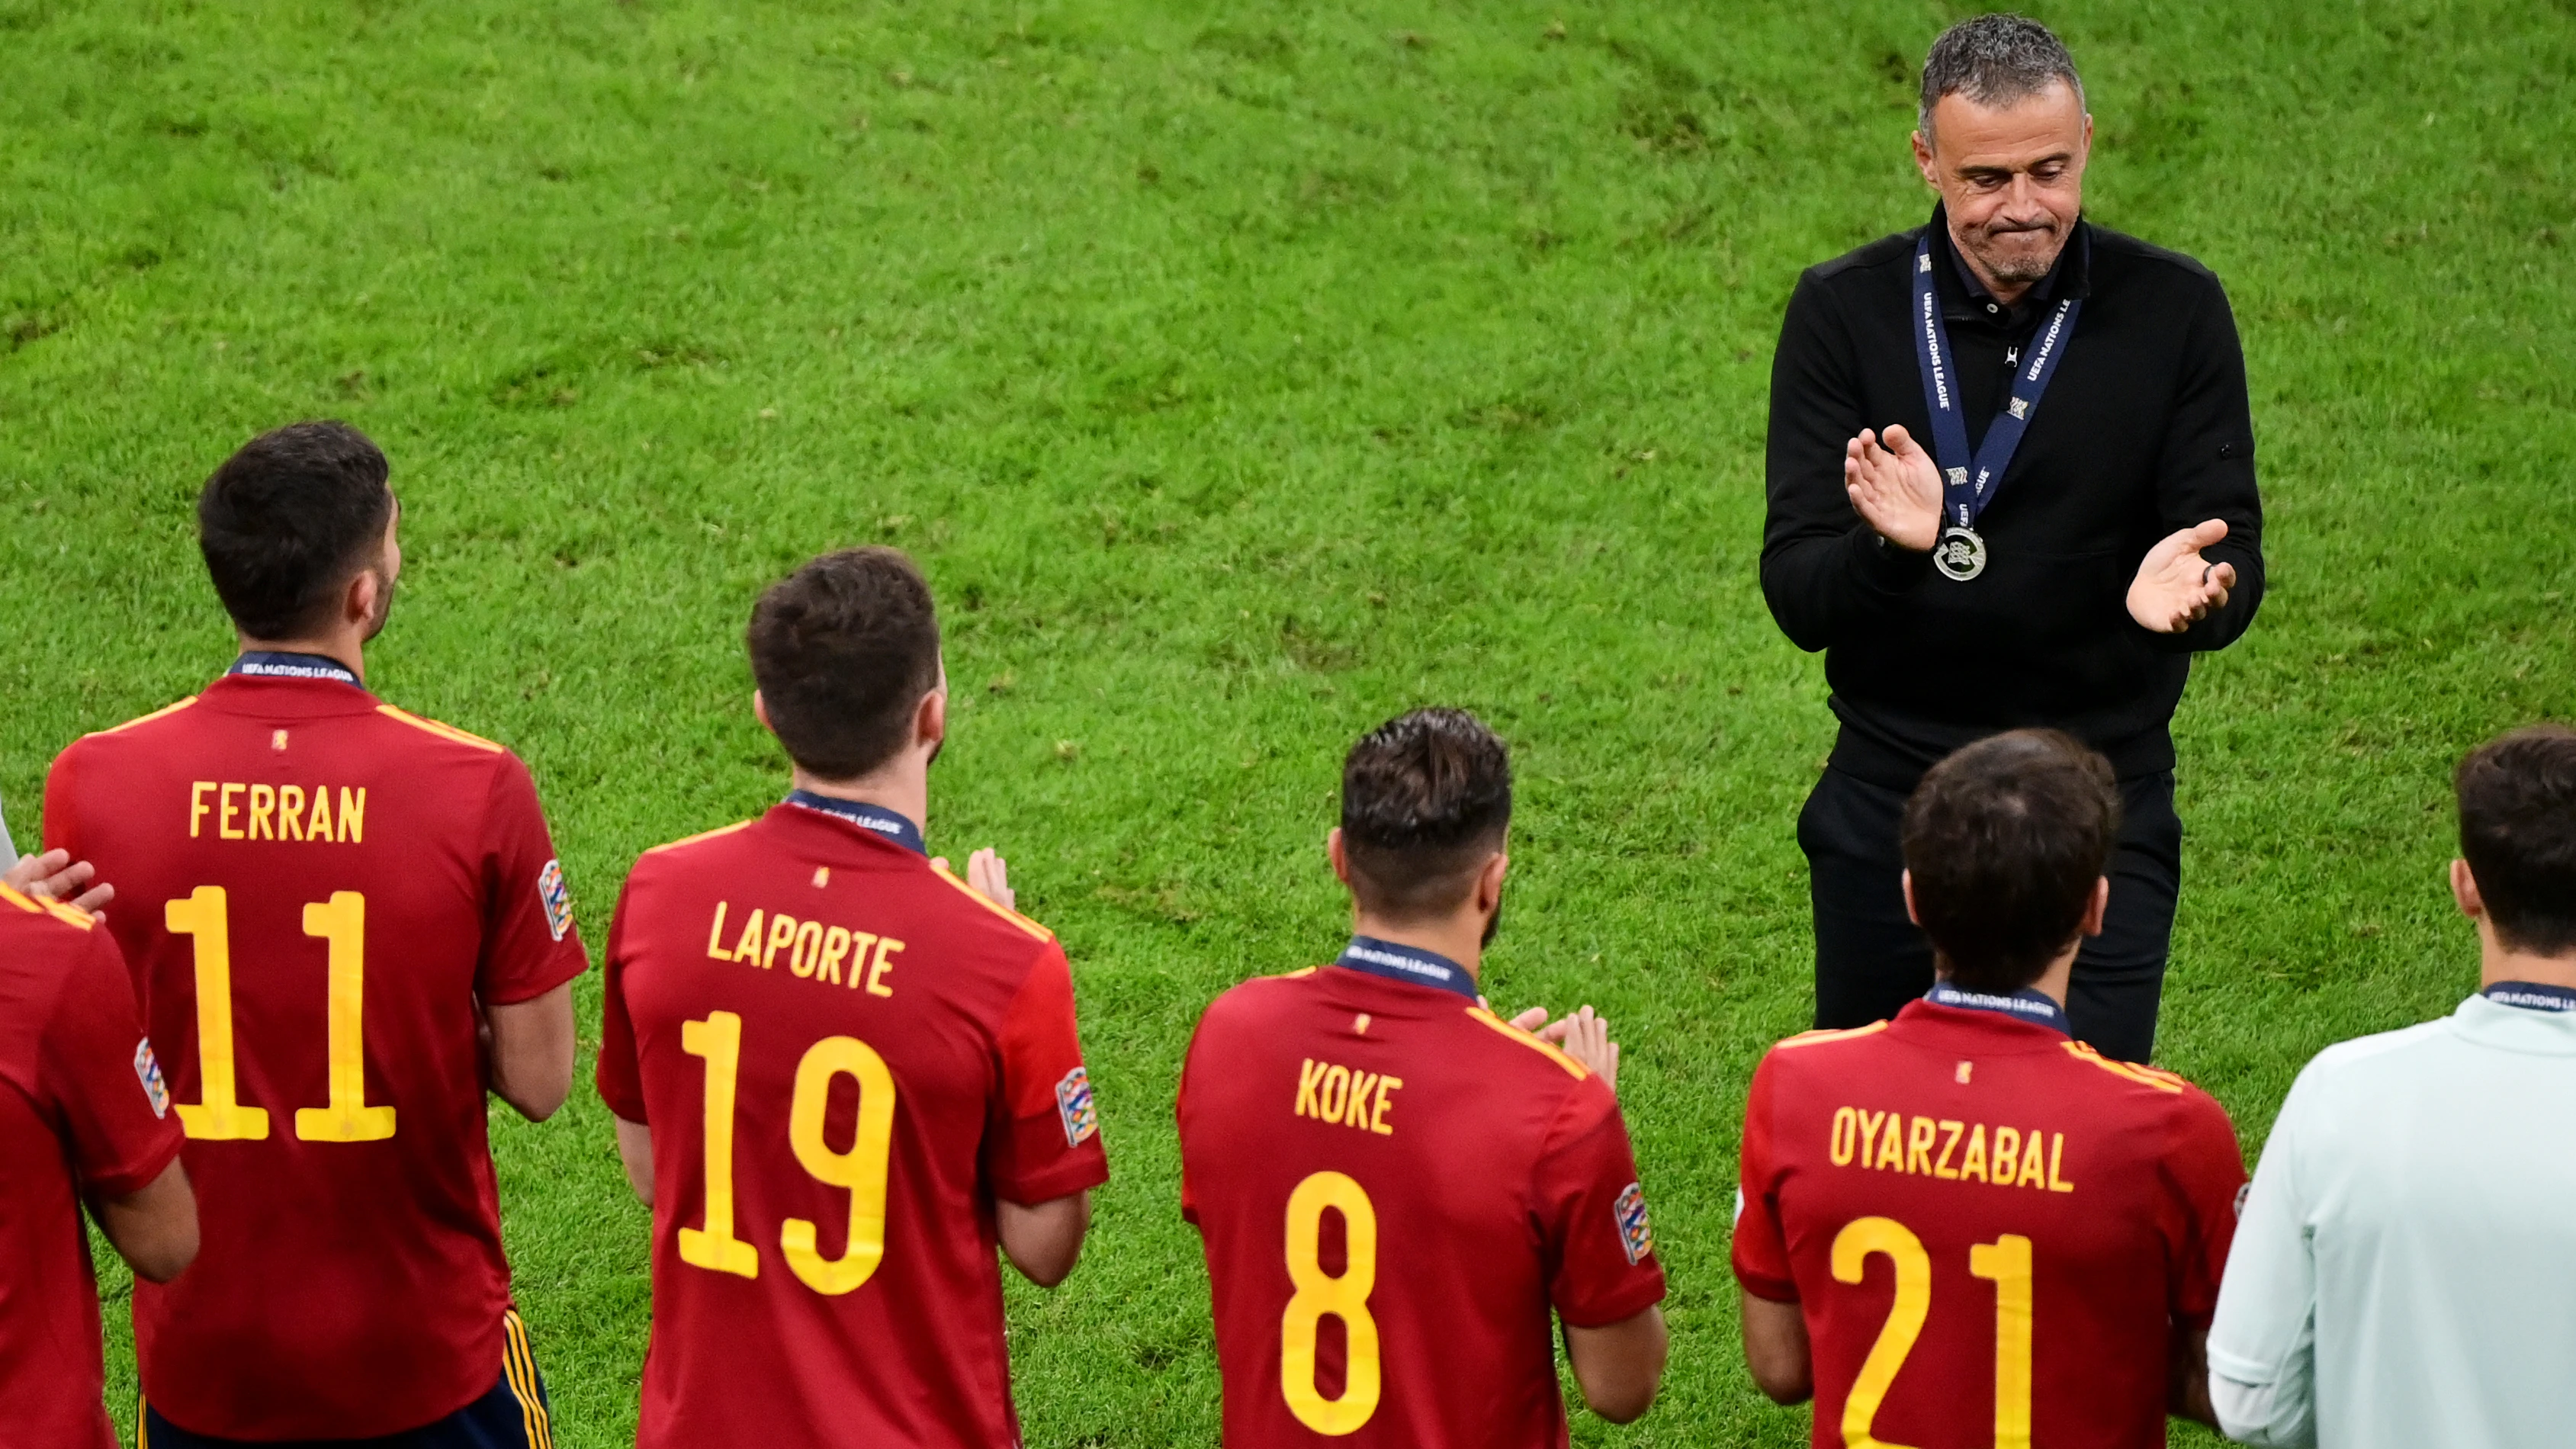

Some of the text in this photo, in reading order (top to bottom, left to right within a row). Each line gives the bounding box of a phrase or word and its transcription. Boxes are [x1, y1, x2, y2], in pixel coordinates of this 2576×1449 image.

[1923, 292, 1950, 410] UEFA NATIONS LEAGUE
[2027, 357, 2045, 381] UEFA
[2040, 311, 2064, 357] NATIONS
[264, 663, 313, 678] NATIONS
[191, 781, 368, 843] FERRAN
[708, 901, 905, 999] LAPORTE
[165, 885, 397, 1144] 11
[1961, 992, 2012, 1010] NATIONS
[2013, 998, 2055, 1017] LEAGUE
[1295, 1059, 1404, 1135] KOKE
[677, 1008, 897, 1296] 19
[1831, 1106, 2075, 1193] OYARZABAL
[1280, 1170, 1382, 1437] 8
[1831, 1216, 2034, 1449] 21
